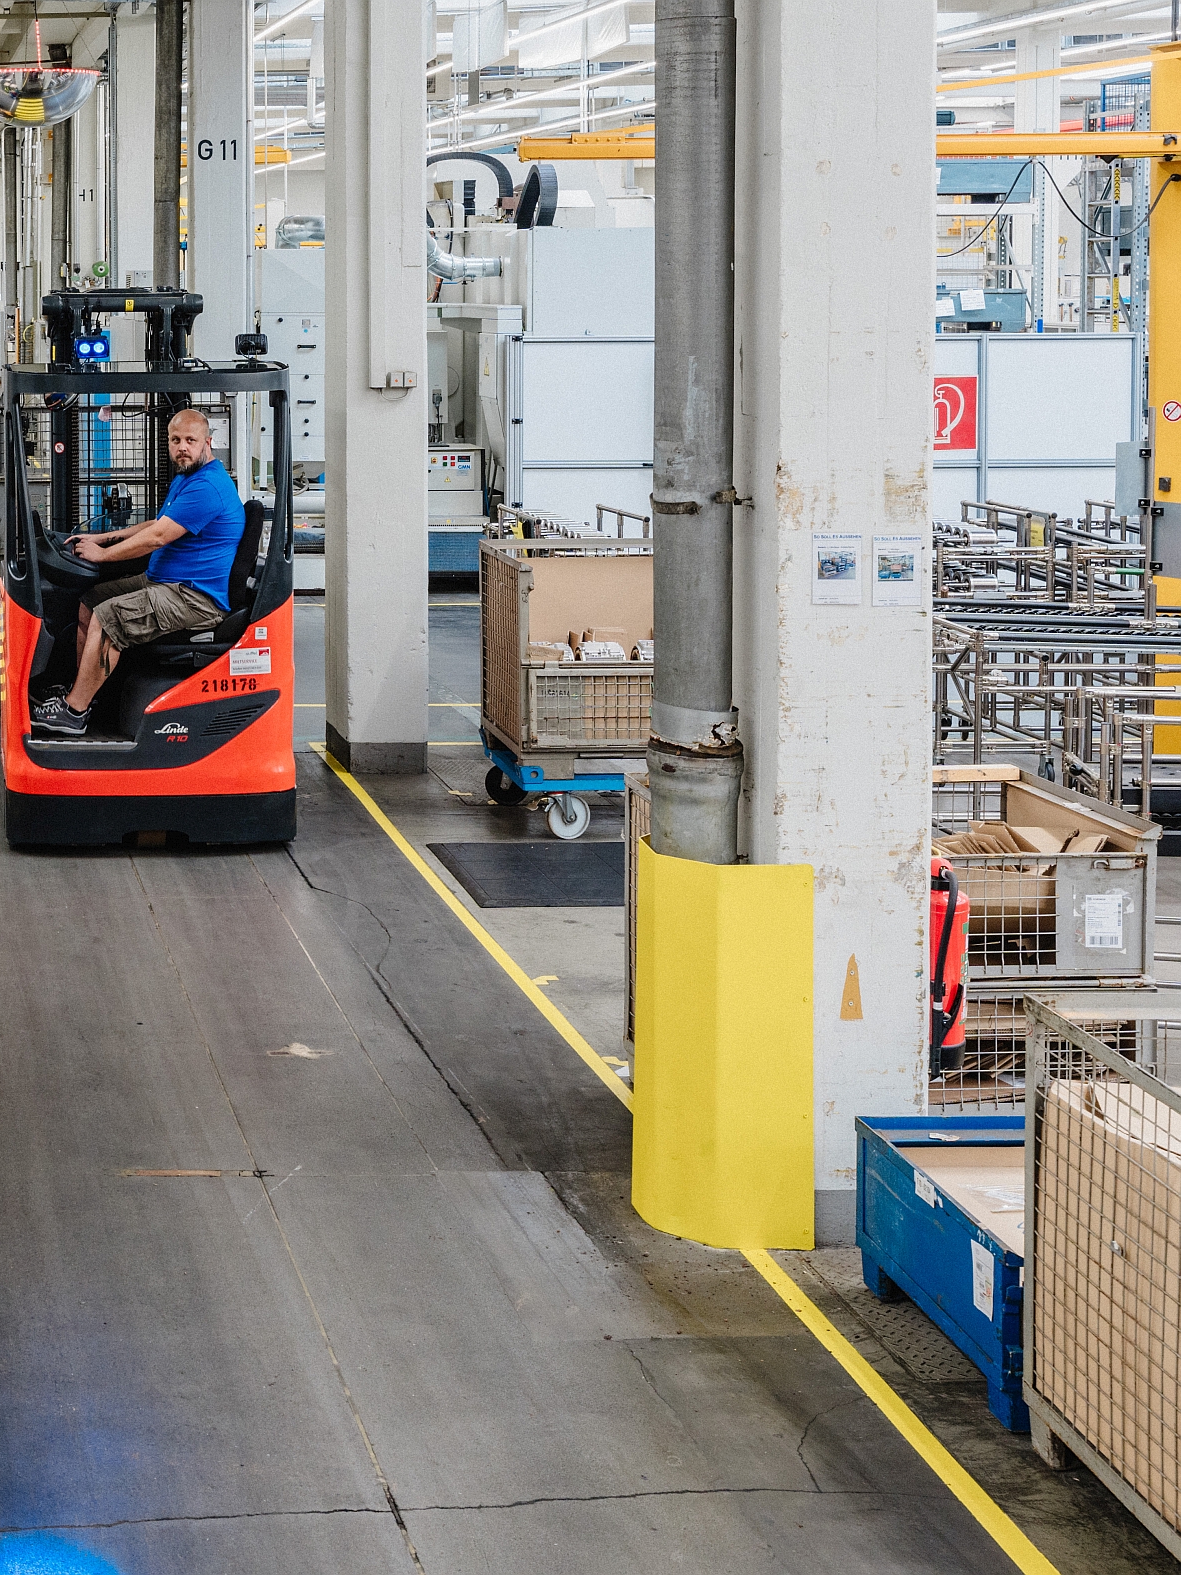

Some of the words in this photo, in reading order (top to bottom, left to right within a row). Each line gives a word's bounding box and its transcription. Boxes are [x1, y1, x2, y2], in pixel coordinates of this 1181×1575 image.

[198, 139, 213, 161] G
[220, 139, 237, 161] 11
[201, 678, 257, 693] 218178
[154, 722, 189, 734] Linde
